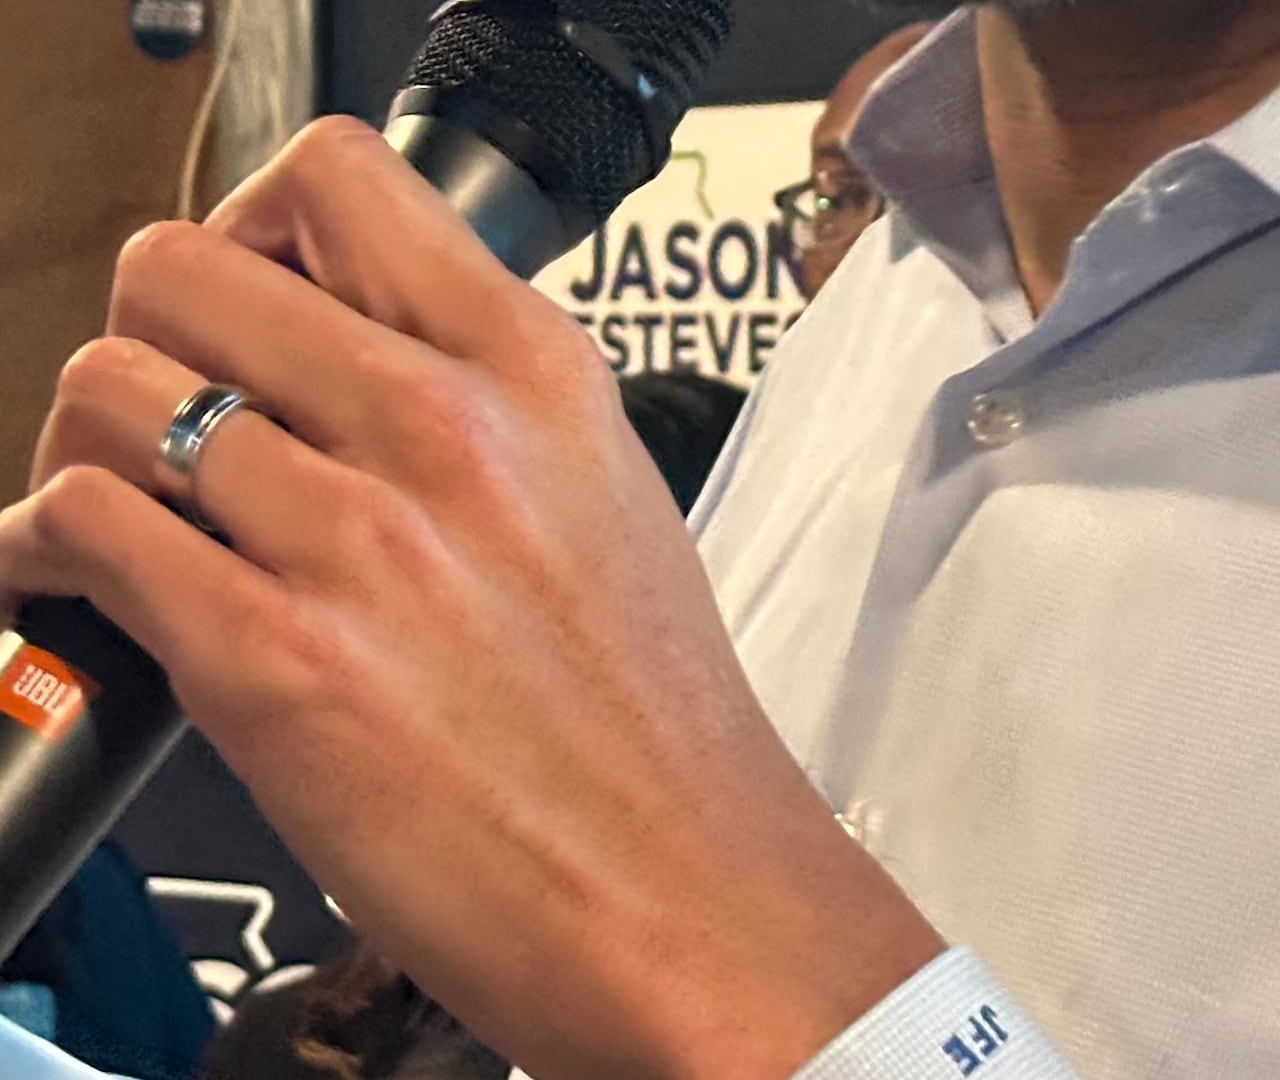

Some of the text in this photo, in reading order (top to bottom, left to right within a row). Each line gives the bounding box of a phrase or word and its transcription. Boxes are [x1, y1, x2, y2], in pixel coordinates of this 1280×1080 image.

[569, 220, 807, 302] JASON
[576, 311, 801, 376] STEVE
[13, 663, 74, 719] JBL
[942, 1004, 1008, 1078] JFE
